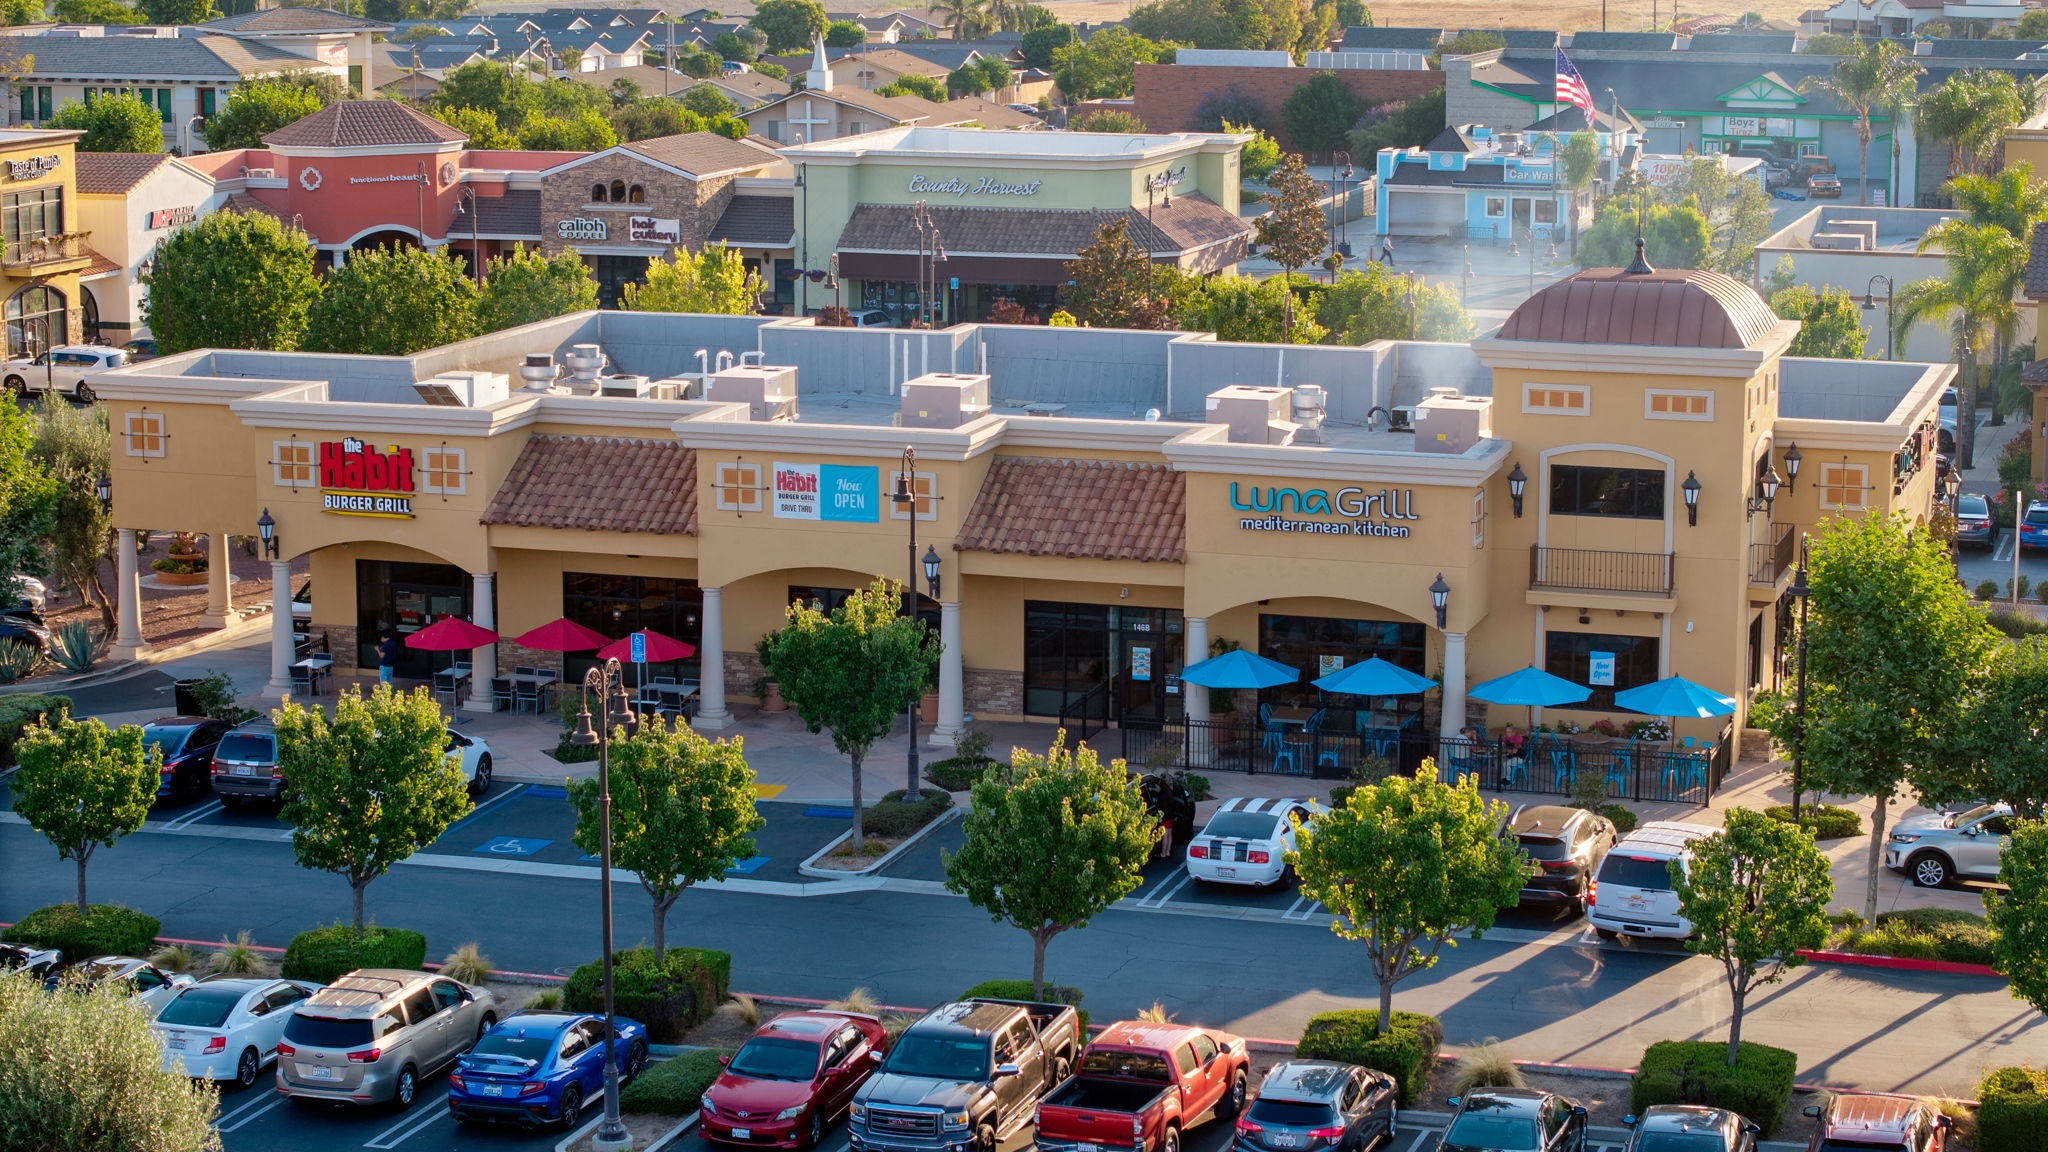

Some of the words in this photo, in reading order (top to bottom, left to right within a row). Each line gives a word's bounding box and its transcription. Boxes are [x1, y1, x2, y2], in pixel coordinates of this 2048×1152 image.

[1729, 117, 1754, 128] Boyz
[1730, 128, 1752, 136] Tirez
[9, 160, 30, 173] Taste
[350, 175, 389, 184] functional
[1509, 169, 1528, 180] Car
[1532, 169, 1562, 181] Wash
[908, 174, 969, 197] Country
[972, 176, 1041, 195] Harvest
[558, 218, 604, 231] calioh
[631, 218, 656, 229] hair
[558, 231, 604, 239] COFFEE
[632, 229, 677, 242] cuttery
[344, 437, 363, 453] the
[320, 441, 414, 492] Habit
[776, 471, 817, 493] Habit
[836, 478, 862, 491] Now
[778, 492, 799, 500] BURGER
[800, 493, 815, 501] GRILL
[834, 493, 865, 509] OPEN
[1230, 481, 1332, 516] Luna
[1335, 486, 1419, 520] Grill
[324, 495, 373, 511] BURGER
[376, 497, 410, 513] GRILL
[781, 503, 797, 512] DRIVE
[798, 504, 813, 513] THRU
[1240, 516, 1349, 535] mediterranean
[1353, 520, 1409, 538] kitchen
[1133, 623, 1150, 632] 146B
[1595, 661, 1610, 670] Now
[1593, 670, 1611, 680] Open
